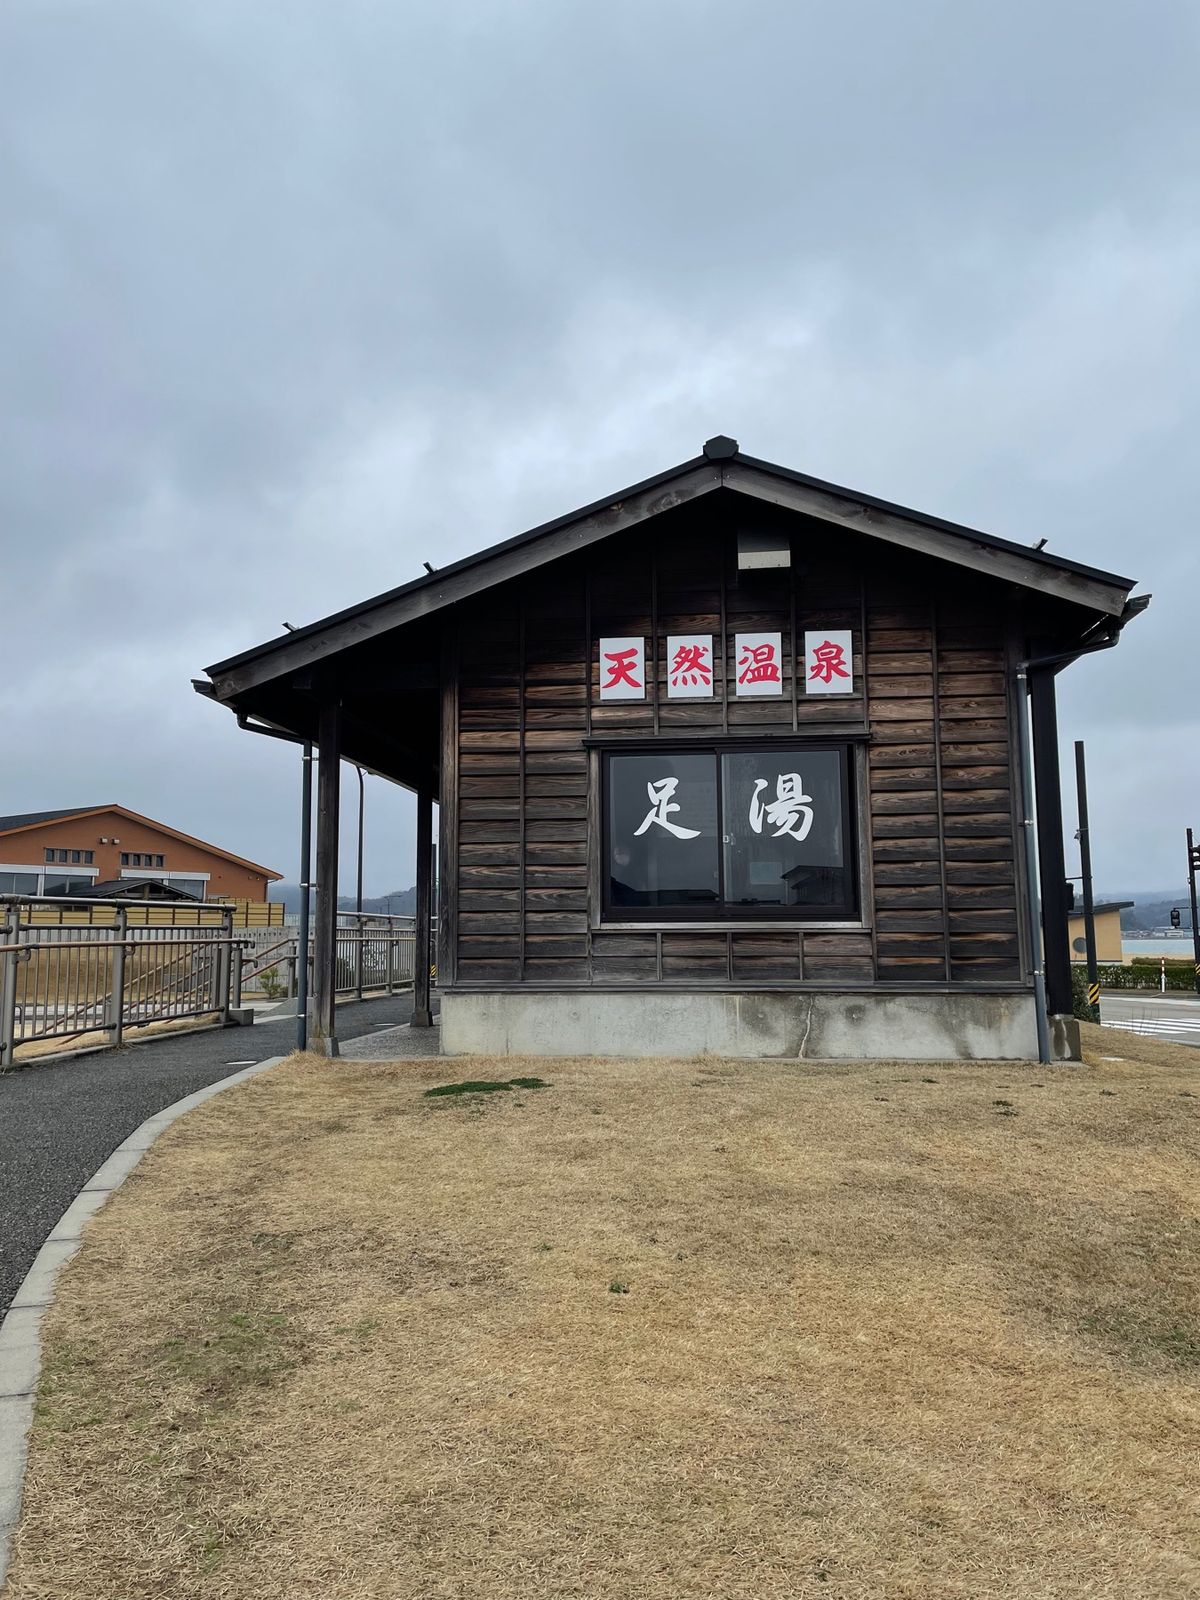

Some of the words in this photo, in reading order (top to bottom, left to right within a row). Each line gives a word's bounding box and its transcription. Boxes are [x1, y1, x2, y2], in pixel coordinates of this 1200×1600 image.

[601, 640, 850, 689] 天然温泉
[633, 773, 814, 842] 足湯
